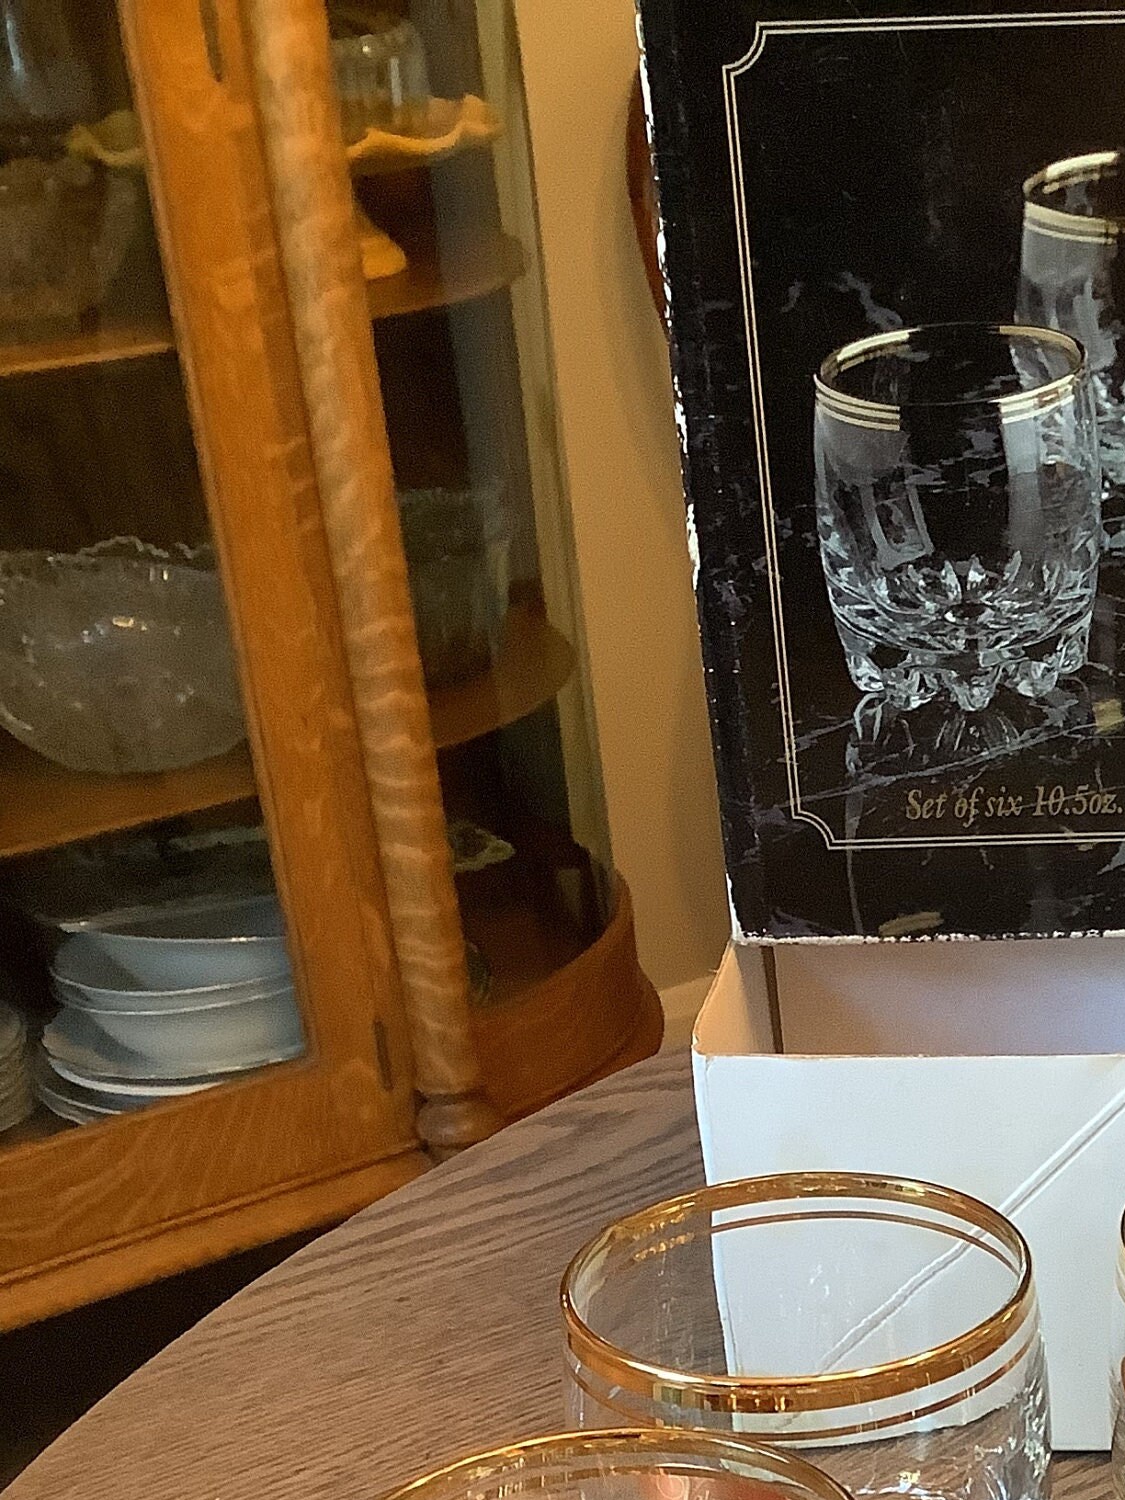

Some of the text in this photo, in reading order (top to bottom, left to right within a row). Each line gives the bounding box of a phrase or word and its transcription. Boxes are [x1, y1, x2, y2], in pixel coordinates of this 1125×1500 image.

[905, 788, 946, 820] Set
[954, 786, 985, 827] of
[986, 788, 1022, 818] six
[1032, 785, 1124, 818] 10.5oz.
